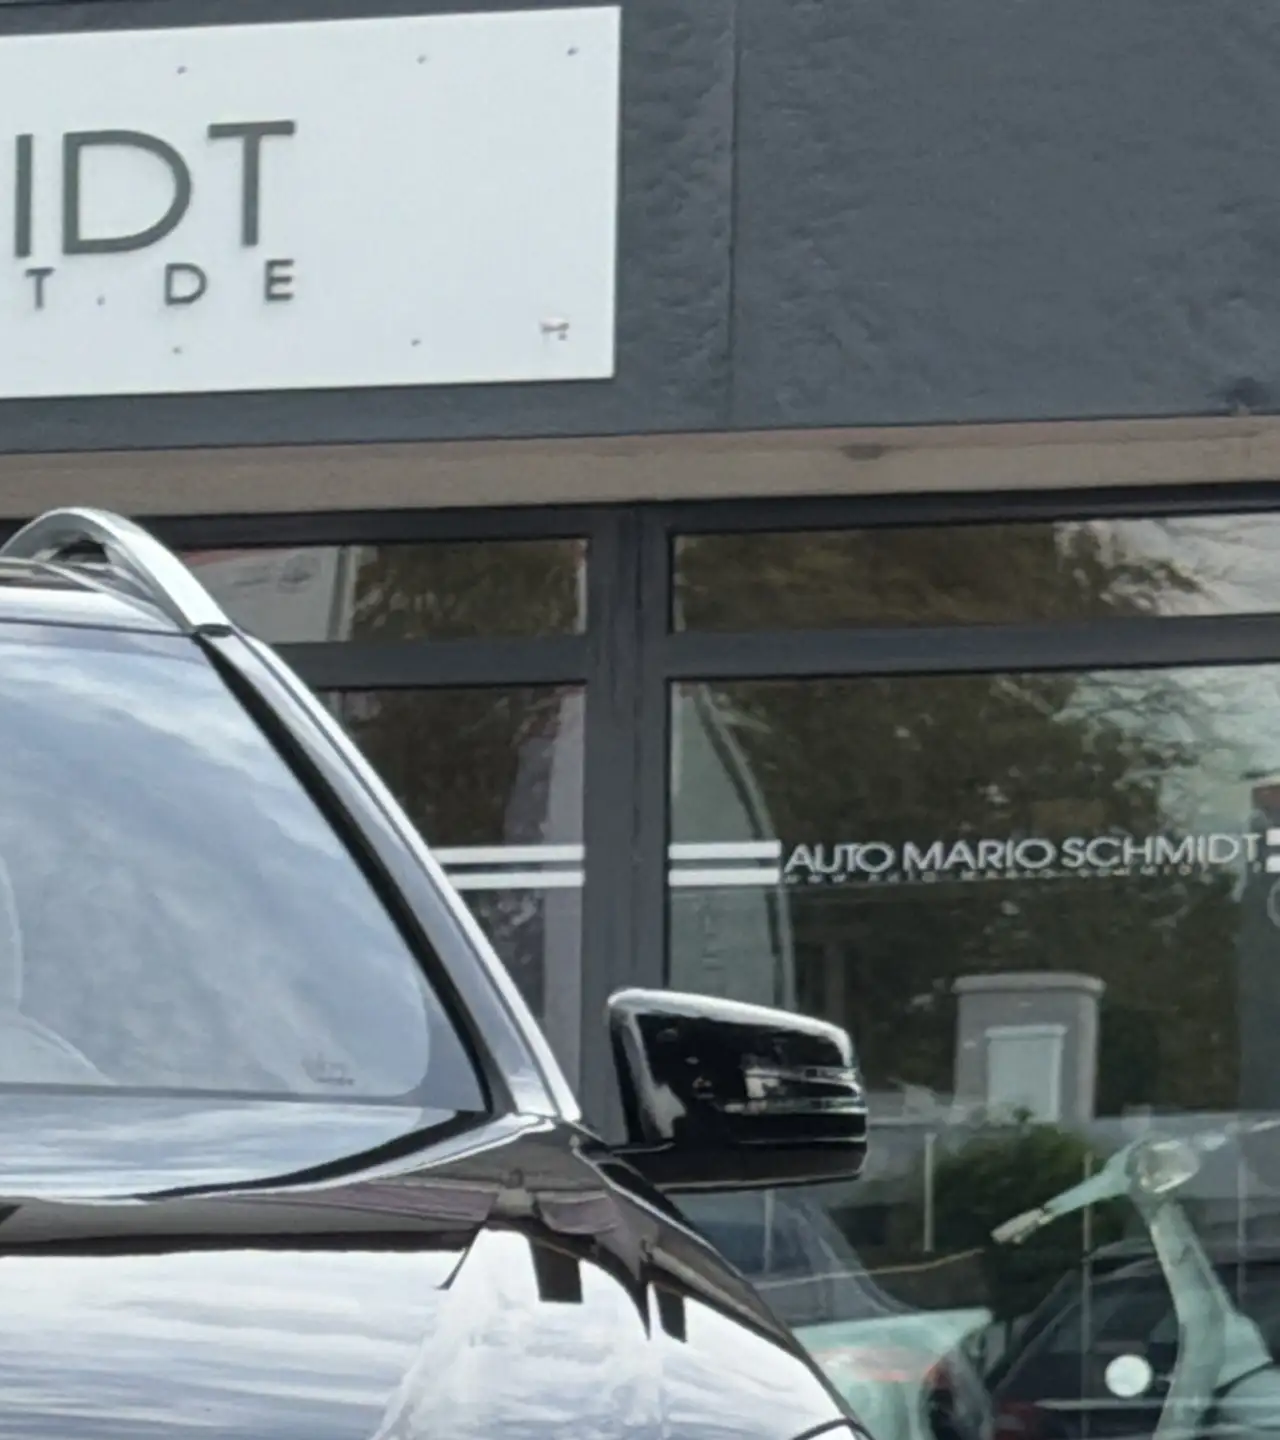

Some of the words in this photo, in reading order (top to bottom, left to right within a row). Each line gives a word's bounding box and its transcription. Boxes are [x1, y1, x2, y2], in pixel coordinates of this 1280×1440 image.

[783, 841, 896, 873] AUTO
[902, 837, 1058, 870] MARIO
[1061, 832, 1262, 868] SCHMIDT
